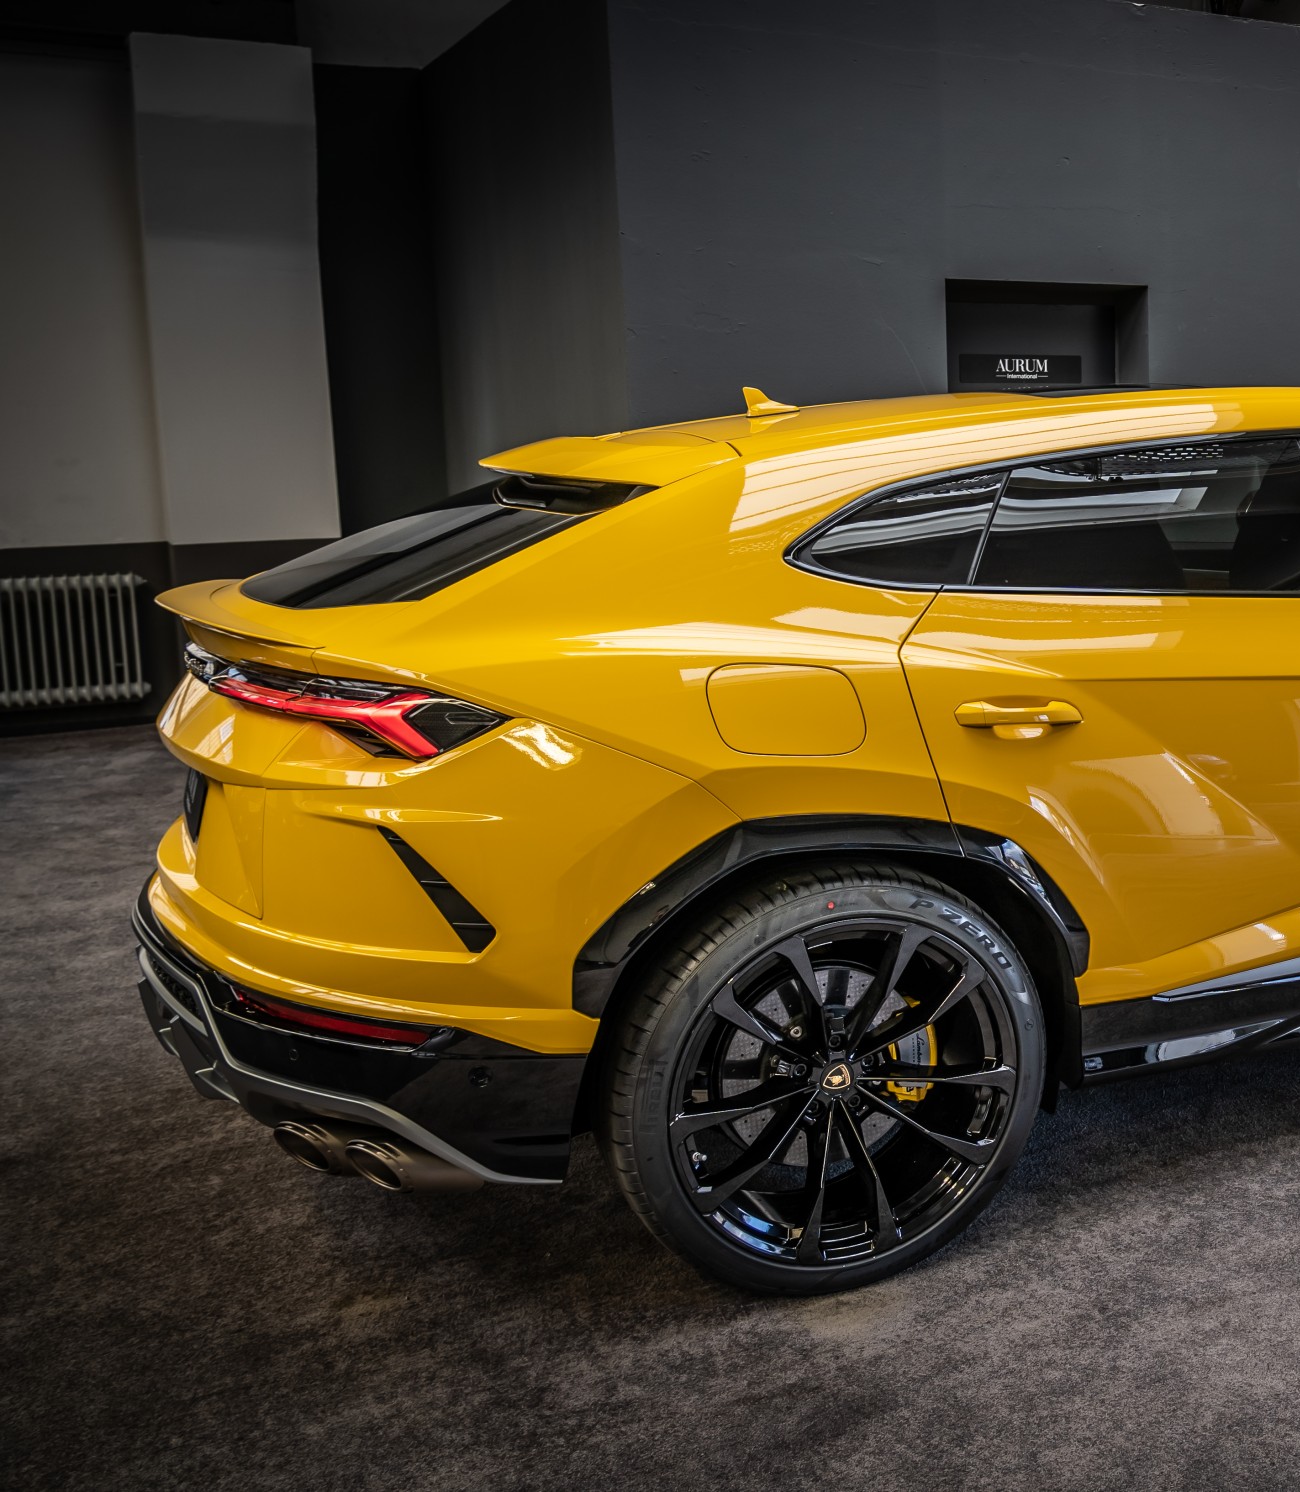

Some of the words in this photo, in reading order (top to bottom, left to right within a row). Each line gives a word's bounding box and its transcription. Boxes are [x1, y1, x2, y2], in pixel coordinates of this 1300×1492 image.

[995, 358, 1049, 373] AURUM
[908, 899, 935, 910] P
[937, 907, 1013, 970] ZERO
